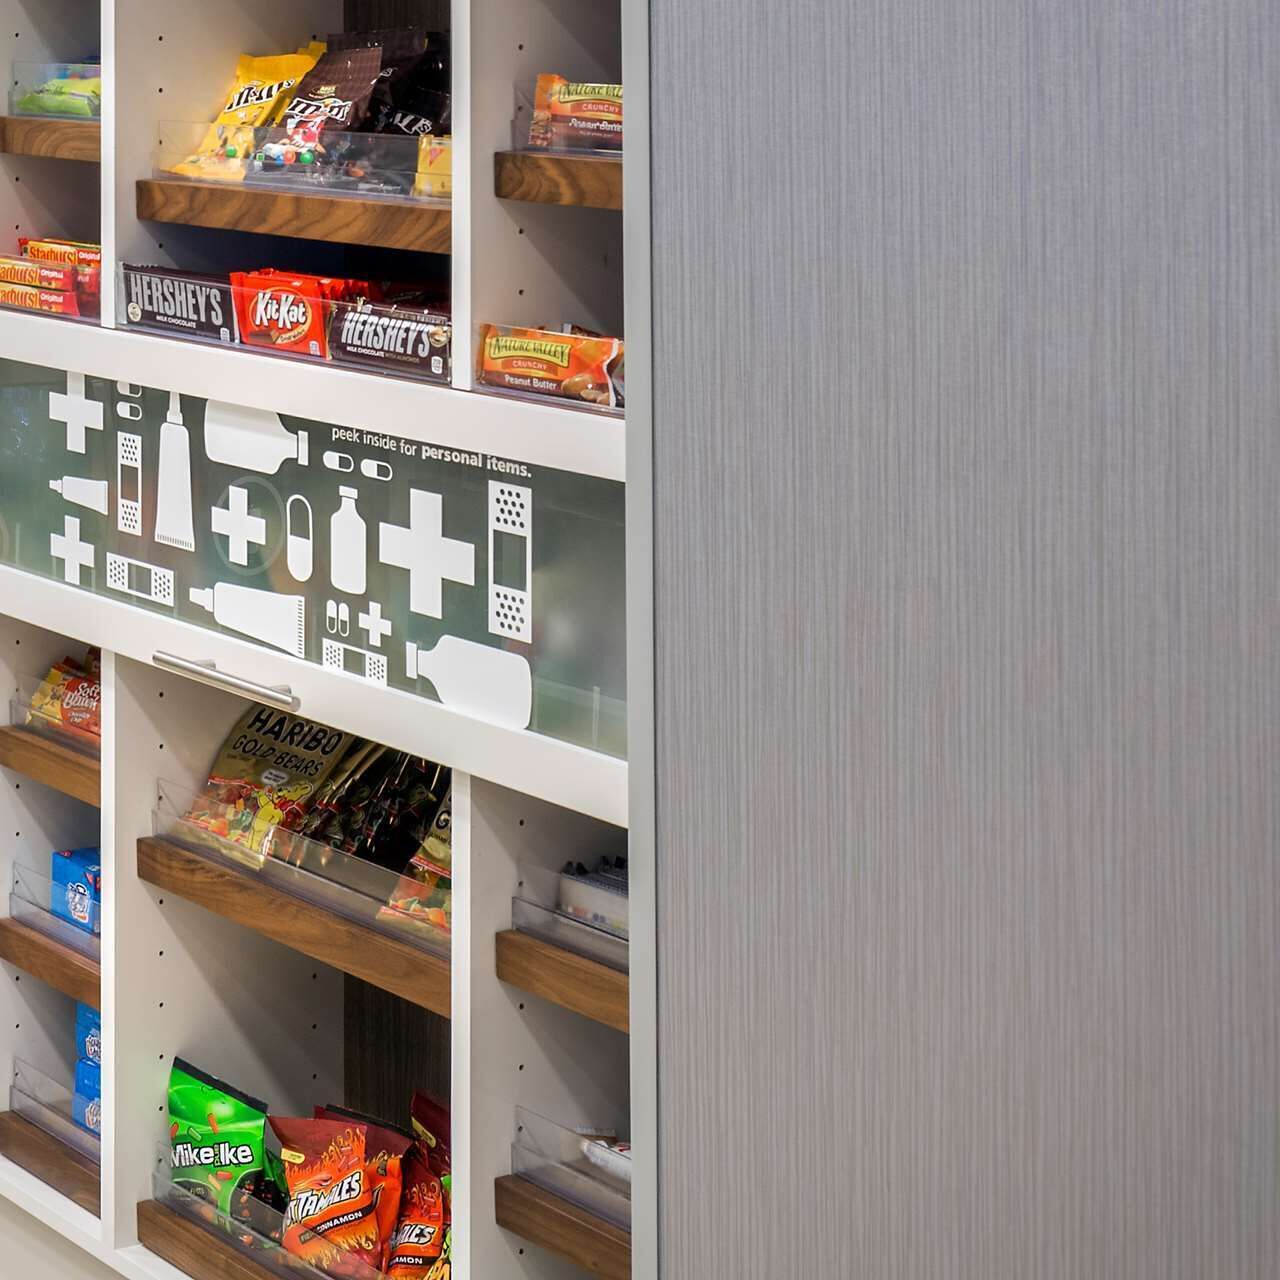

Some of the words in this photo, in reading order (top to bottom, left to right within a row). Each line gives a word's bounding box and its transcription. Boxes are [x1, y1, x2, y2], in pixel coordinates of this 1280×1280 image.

[582, 103, 620, 113] CRUNCHY
[130, 273, 223, 326] HERSHEY'S
[168, 316, 197, 329] CHOCOLATE
[341, 311, 430, 358] HERSHEY'S
[357, 347, 385, 358] CHOCOLATE
[494, 336, 531, 355] NATURE
[532, 341, 568, 363] VALLEY
[512, 359, 547, 370] CRUNCHY
[504, 374, 531, 387] Peanut
[532, 377, 557, 390] Butter
[332, 427, 360, 443] peek
[363, 430, 397, 451] inside
[399, 438, 418, 456] for
[421, 443, 482, 468] personal
[486, 454, 533, 478] items.
[247, 708, 344, 755] HARIBO
[171, 1143, 215, 1168] Mike
[220, 1142, 253, 1166] Ike
